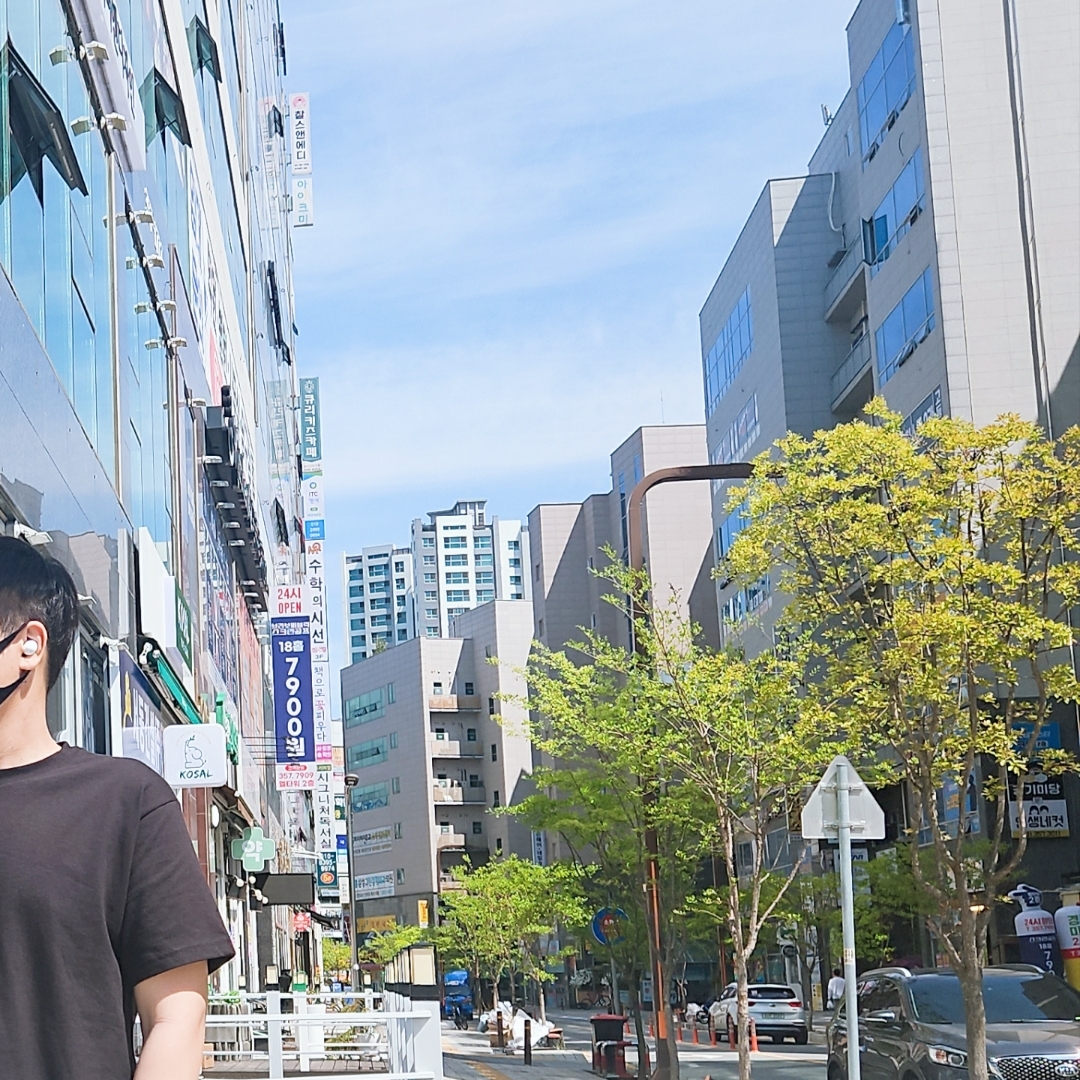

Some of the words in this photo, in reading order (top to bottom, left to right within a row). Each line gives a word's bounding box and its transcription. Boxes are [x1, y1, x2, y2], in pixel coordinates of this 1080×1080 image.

[277, 587, 301, 600] 24시
[278, 601, 302, 614] OPEN
[279, 640, 304, 653] 18홀
[179, 769, 214, 780] KOSAL
[241, 840, 263, 862] 약
